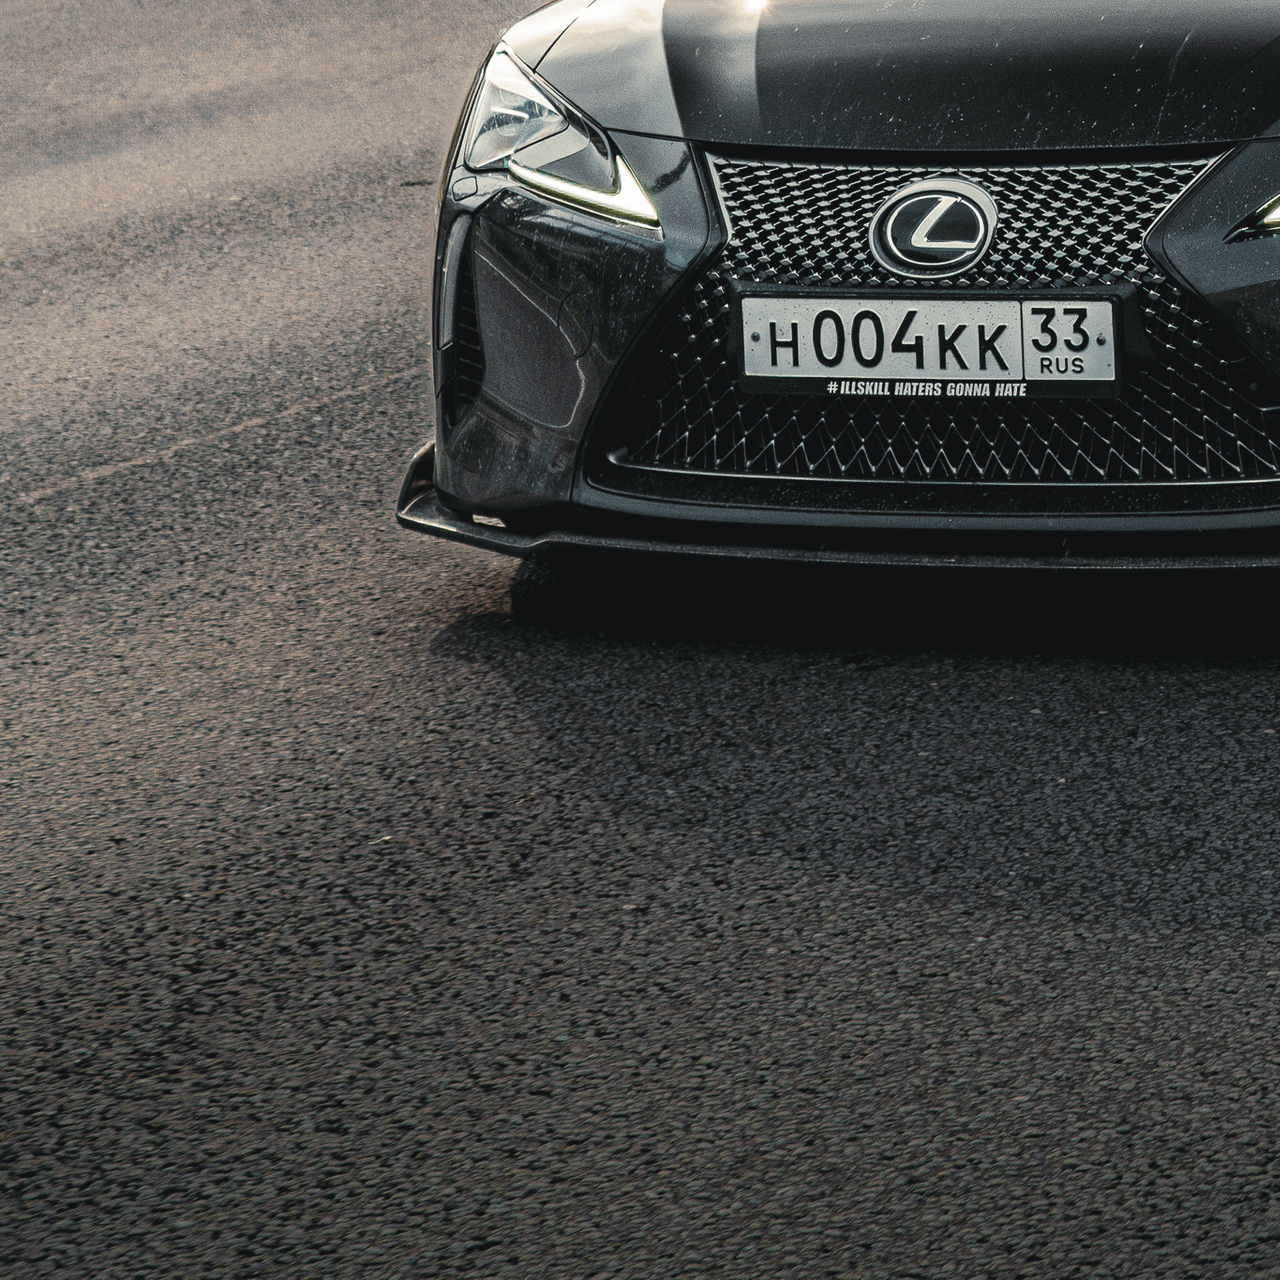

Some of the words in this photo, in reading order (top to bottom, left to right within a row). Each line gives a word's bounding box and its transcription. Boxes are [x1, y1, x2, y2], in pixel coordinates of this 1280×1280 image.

[768, 308, 1010, 372] H004KK
[1030, 307, 1090, 353] 33
[1039, 356, 1085, 375] RUS
[893, 381, 943, 397] HATERS
[945, 382, 991, 398] GONNA
[994, 382, 1028, 398] HATE
